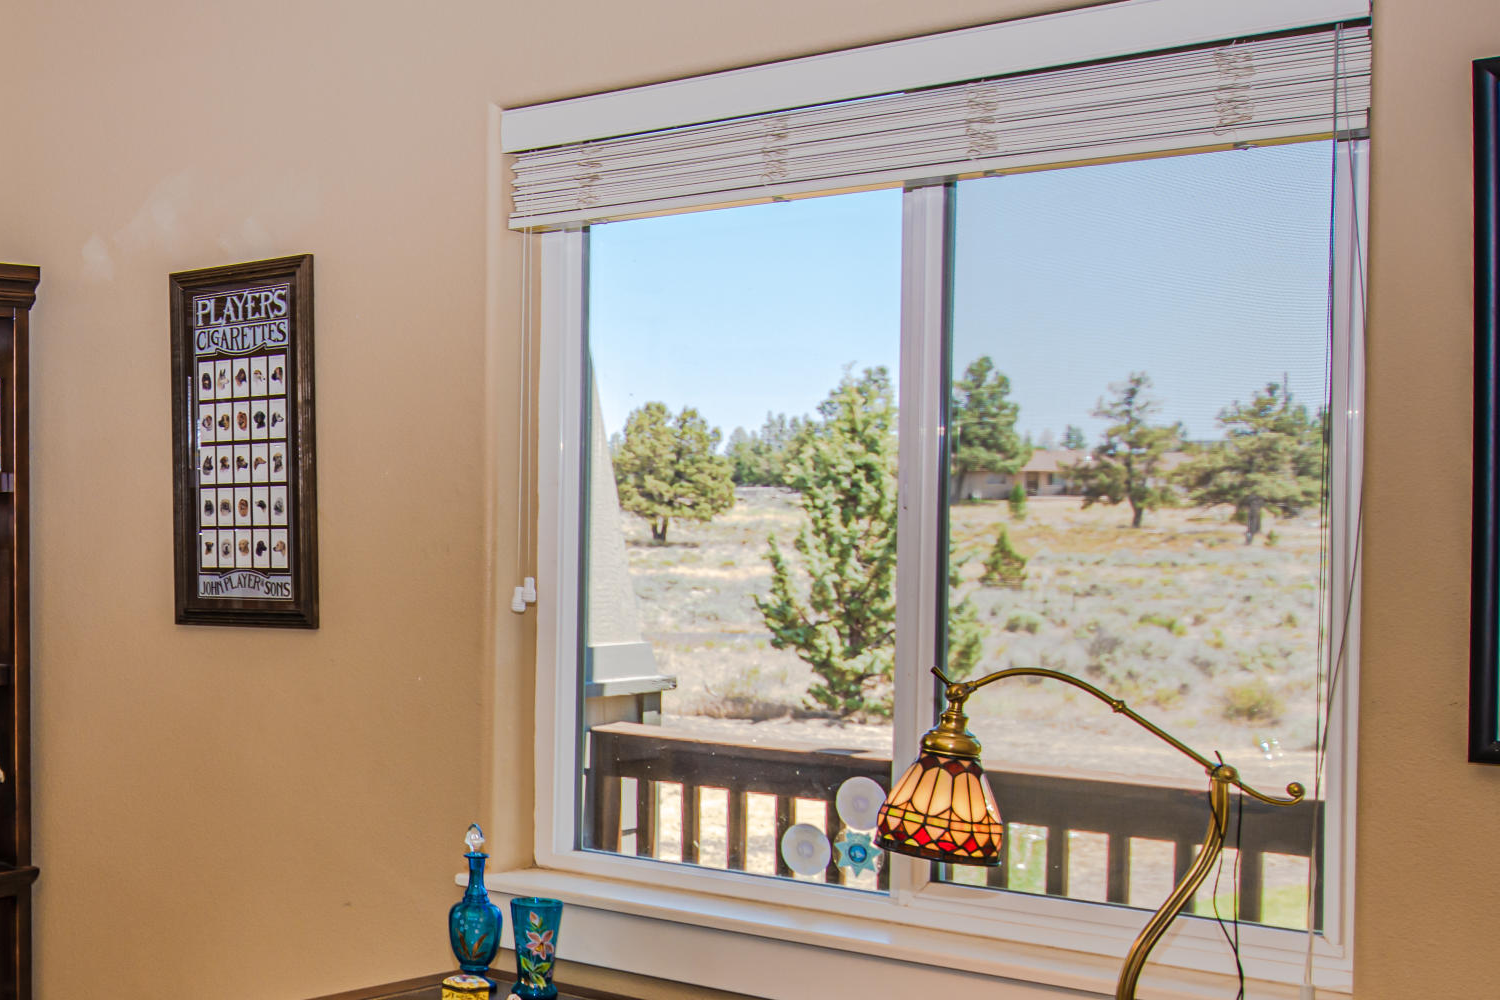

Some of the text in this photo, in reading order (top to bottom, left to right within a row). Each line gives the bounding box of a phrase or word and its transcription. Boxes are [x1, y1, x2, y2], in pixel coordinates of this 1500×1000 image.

[195, 288, 287, 327] PLAYER'S
[196, 321, 287, 351] CIGARETTES
[200, 580, 224, 595] JOHN
[223, 573, 261, 591] PLAYER
[263, 581, 291, 597] SONS
